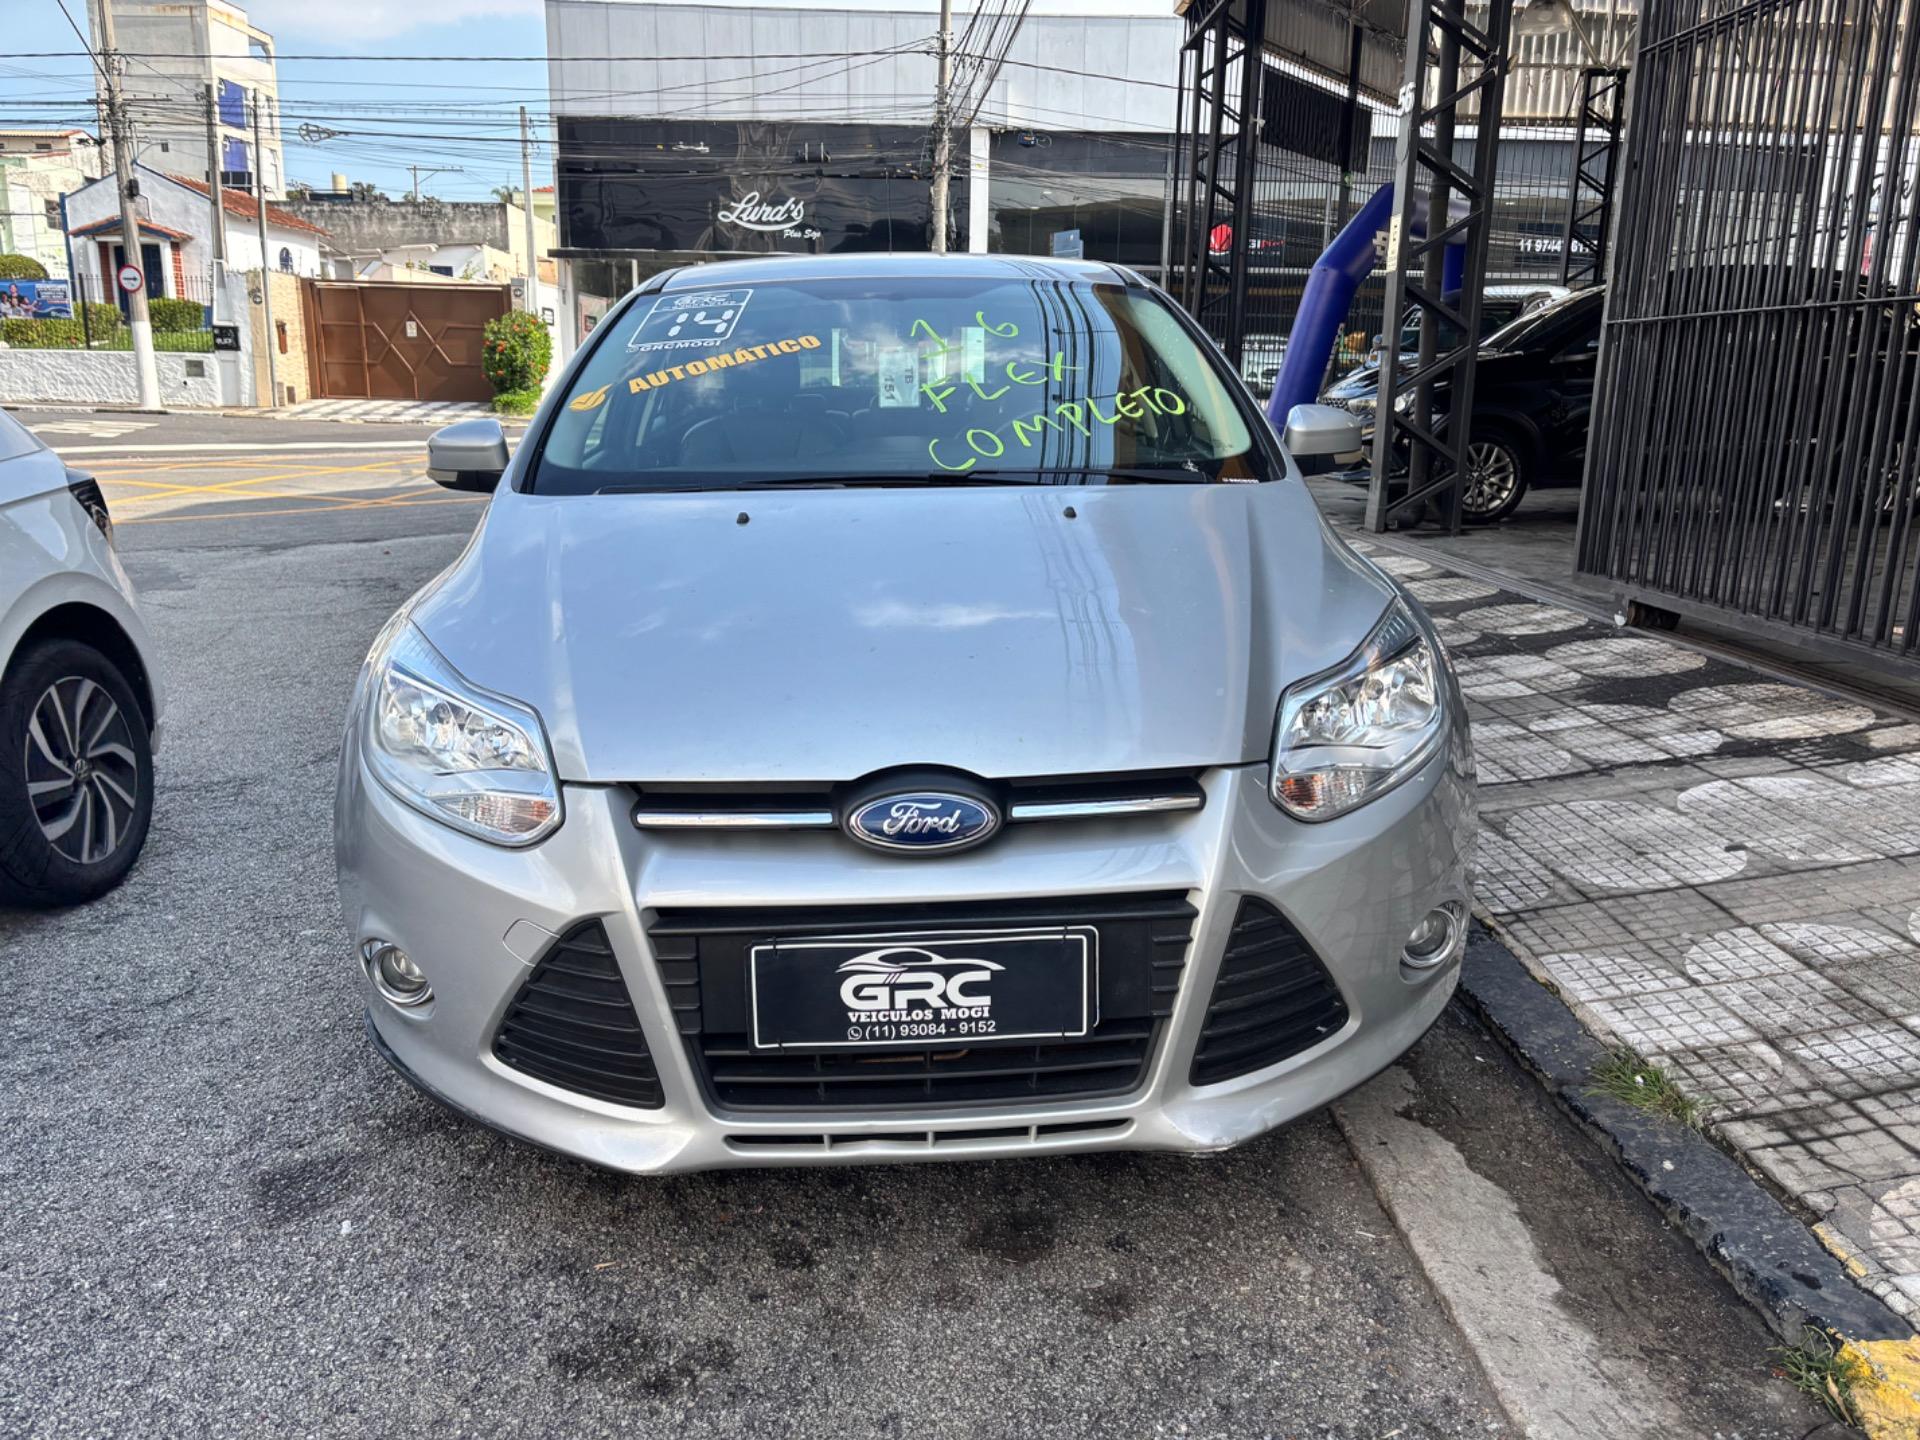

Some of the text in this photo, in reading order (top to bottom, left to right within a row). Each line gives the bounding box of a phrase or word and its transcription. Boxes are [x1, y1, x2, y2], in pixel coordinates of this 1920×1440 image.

[668, 309, 735, 337] 14
[628, 335, 822, 394] AUTOMÁTICO
[919, 351, 1085, 413] FLEX
[928, 386, 1186, 471] COMPLETO
[883, 801, 962, 835] Ford
[840, 970, 993, 1012] GRC
[847, 1006, 990, 1023] VEICULOS MOGI
[865, 1025, 896, 1040] (11)
[900, 1023, 947, 1036] 93084
[959, 1020, 997, 1034] 9152
